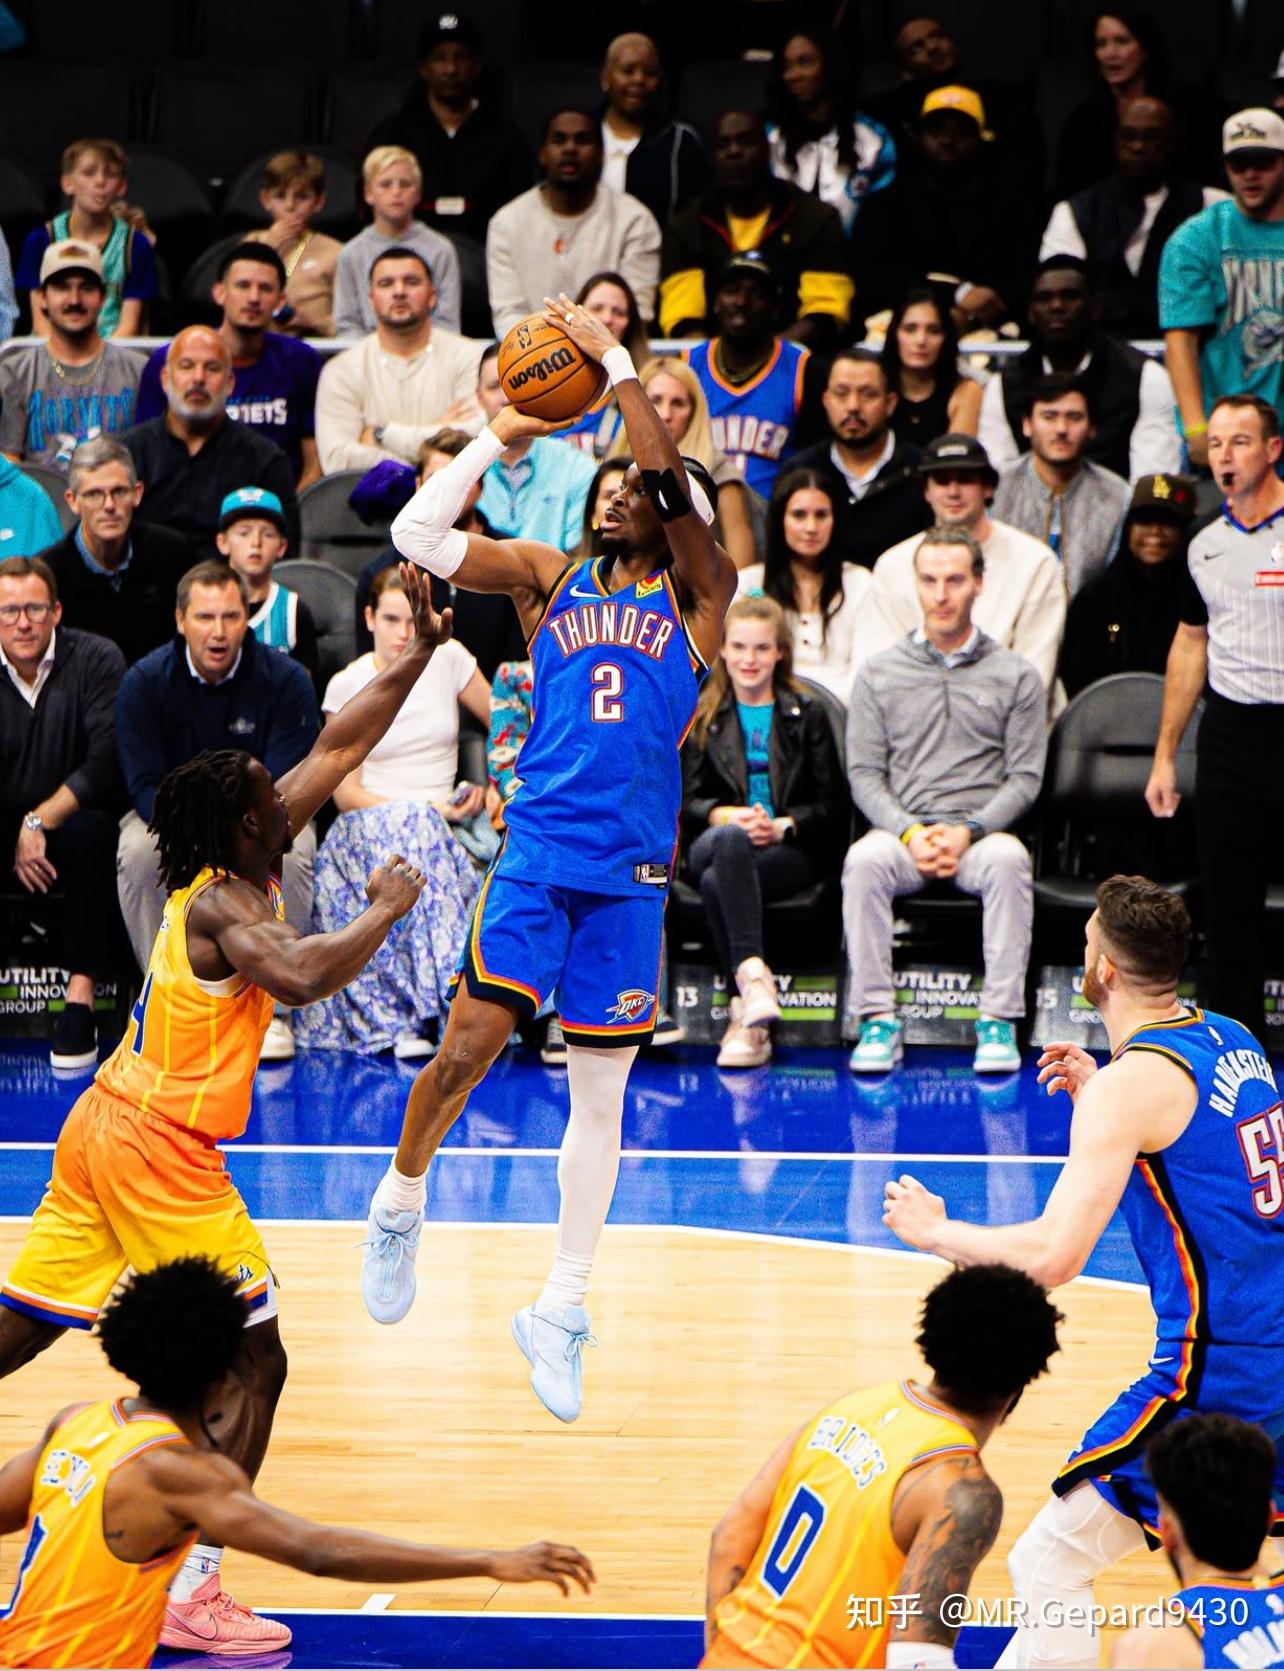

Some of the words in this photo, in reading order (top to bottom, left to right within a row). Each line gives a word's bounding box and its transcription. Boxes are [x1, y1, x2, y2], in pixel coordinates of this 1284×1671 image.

[508, 347, 577, 391] Wilson
[710, 414, 789, 460] UNDER
[547, 601, 675, 662] THUNDER
[591, 661, 624, 722] 2
[0, 967, 71, 984] UTILITY
[894, 971, 972, 990] UTILITY
[20, 983, 117, 999] INNOVON
[676, 986, 699, 1007] 13
[777, 992, 838, 1007] VATION
[1036, 988, 1058, 1008] 15
[760, 1483, 827, 1600] 0
